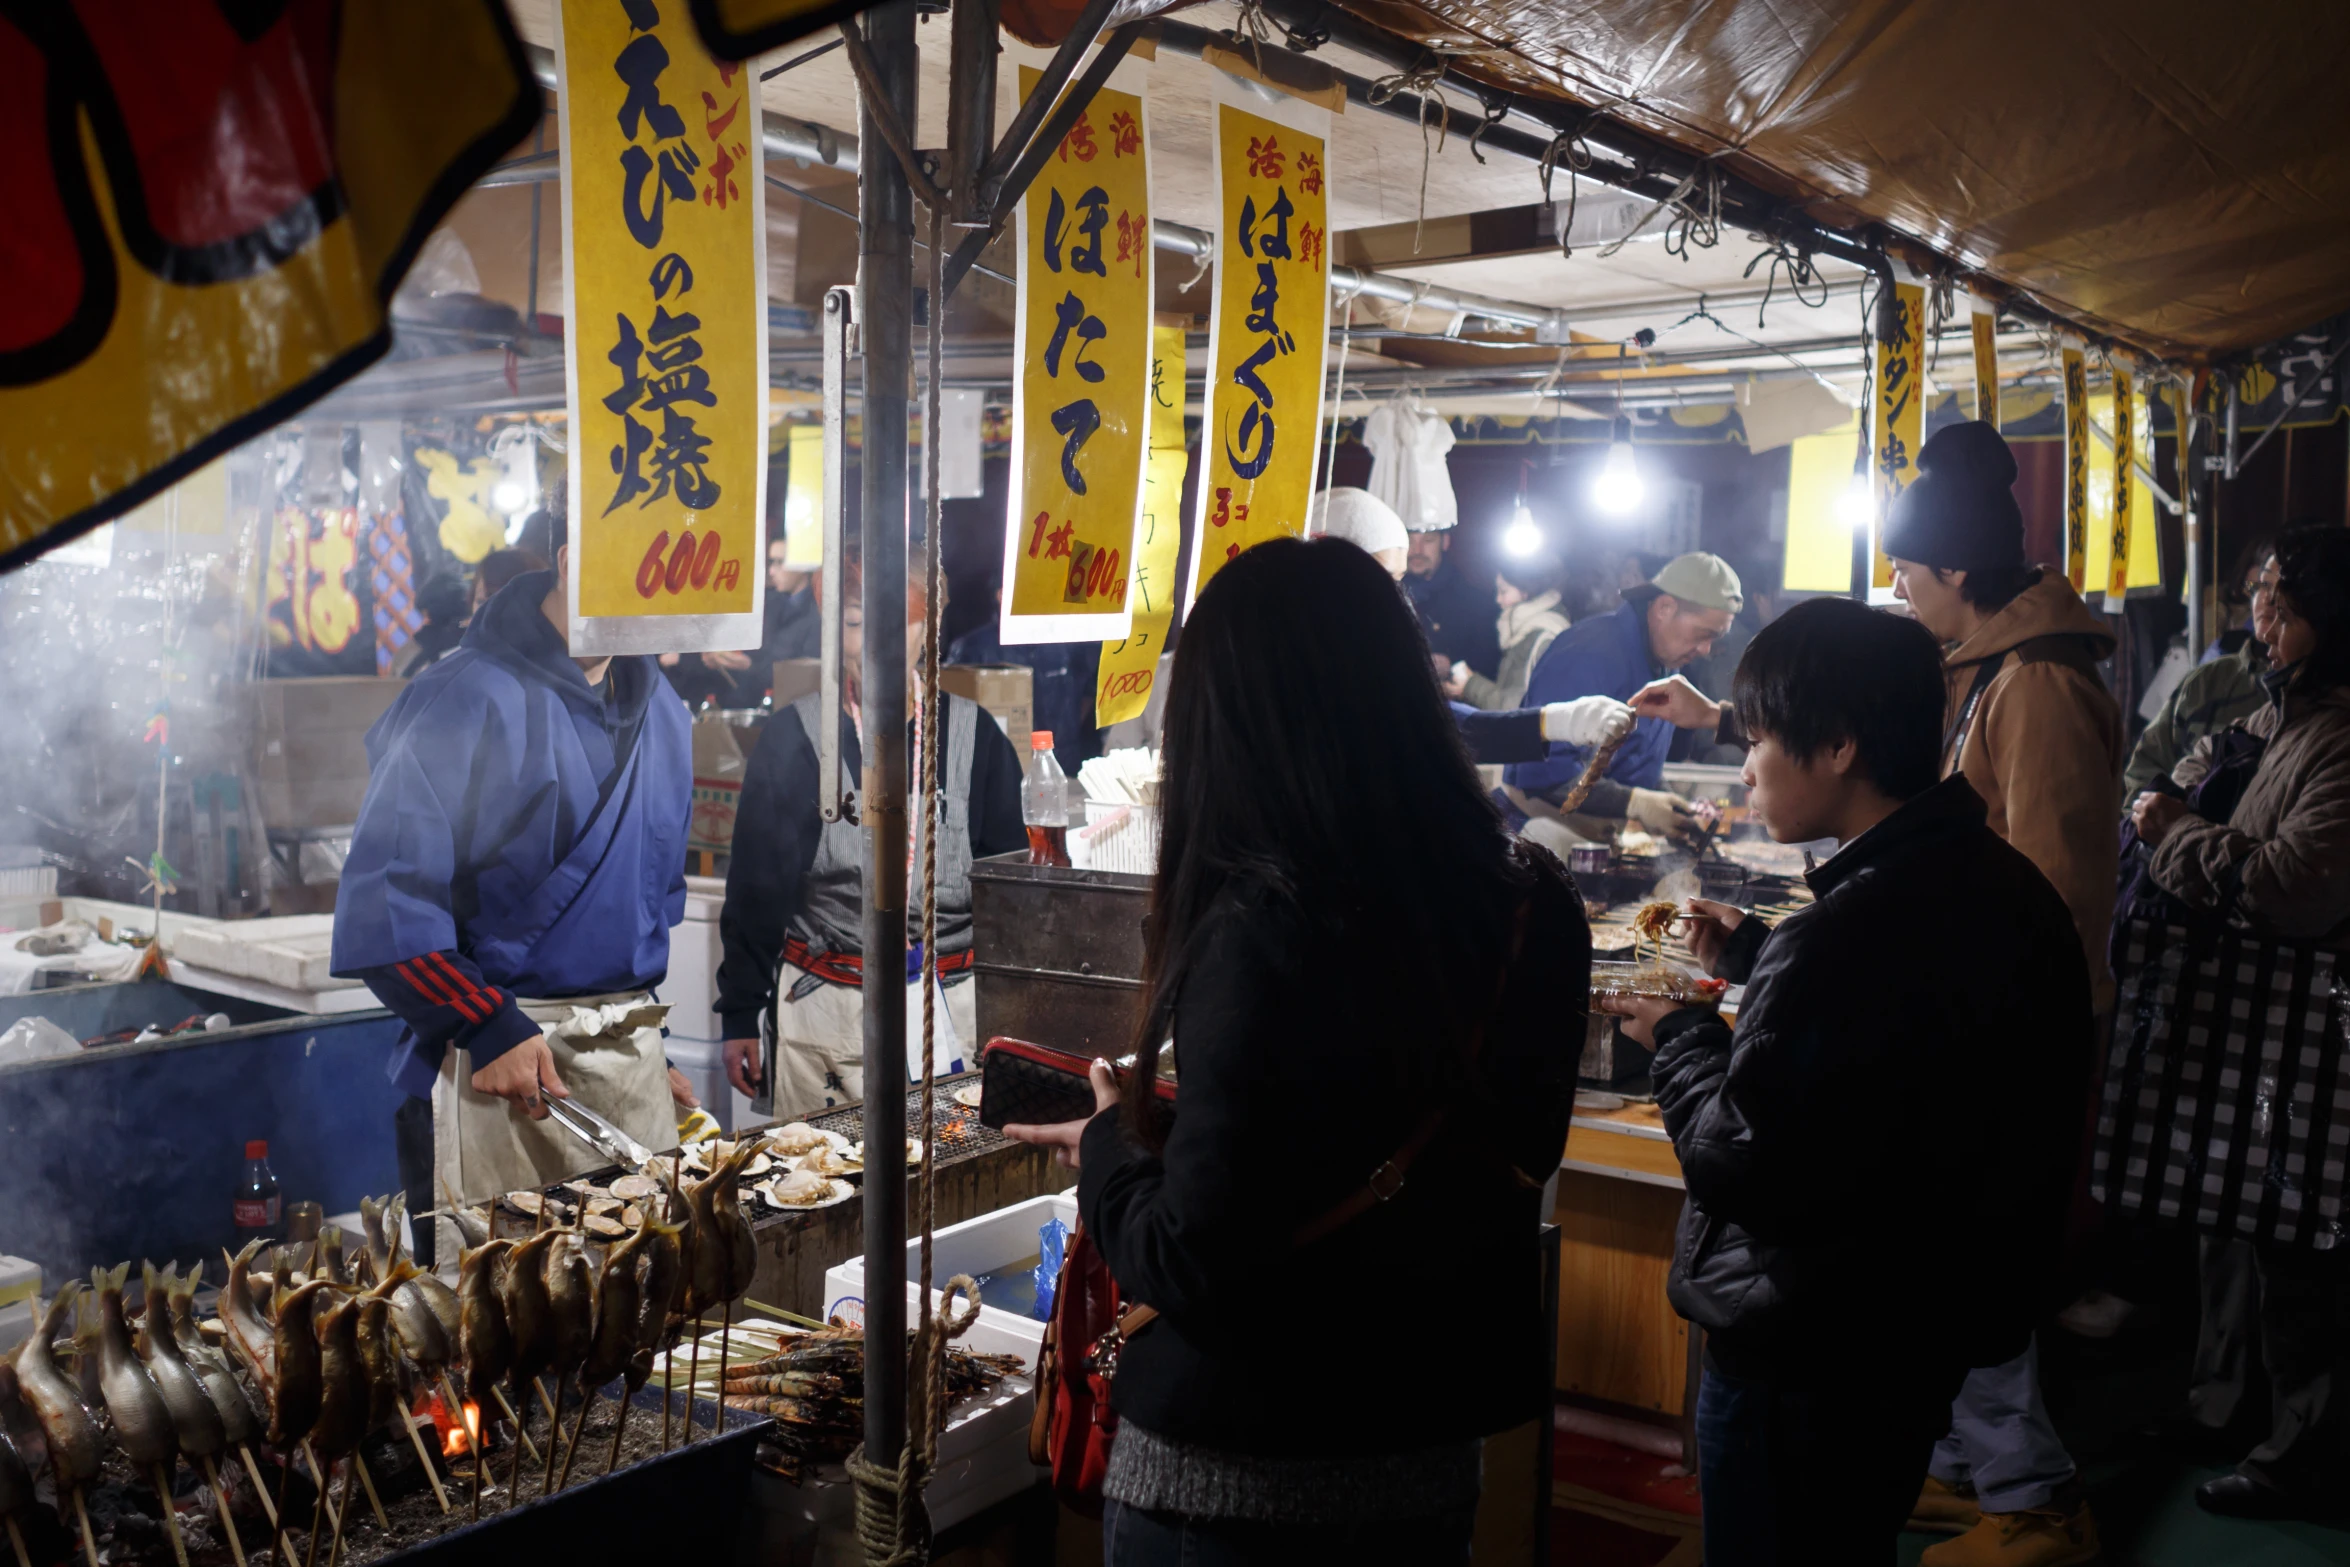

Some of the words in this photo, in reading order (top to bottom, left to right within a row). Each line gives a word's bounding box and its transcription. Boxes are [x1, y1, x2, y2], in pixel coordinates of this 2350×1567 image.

[1109, 110, 1146, 279] 海鮮
[1246, 134, 1286, 180] 活
[1296, 151, 1325, 272] 海鮮
[1044, 185, 1110, 496] ほたて
[1225, 185, 1296, 480] はまぐり
[636, 529, 740, 600] 600円
[1067, 546, 1128, 605] 600円
[1098, 669, 1152, 710] 1000
